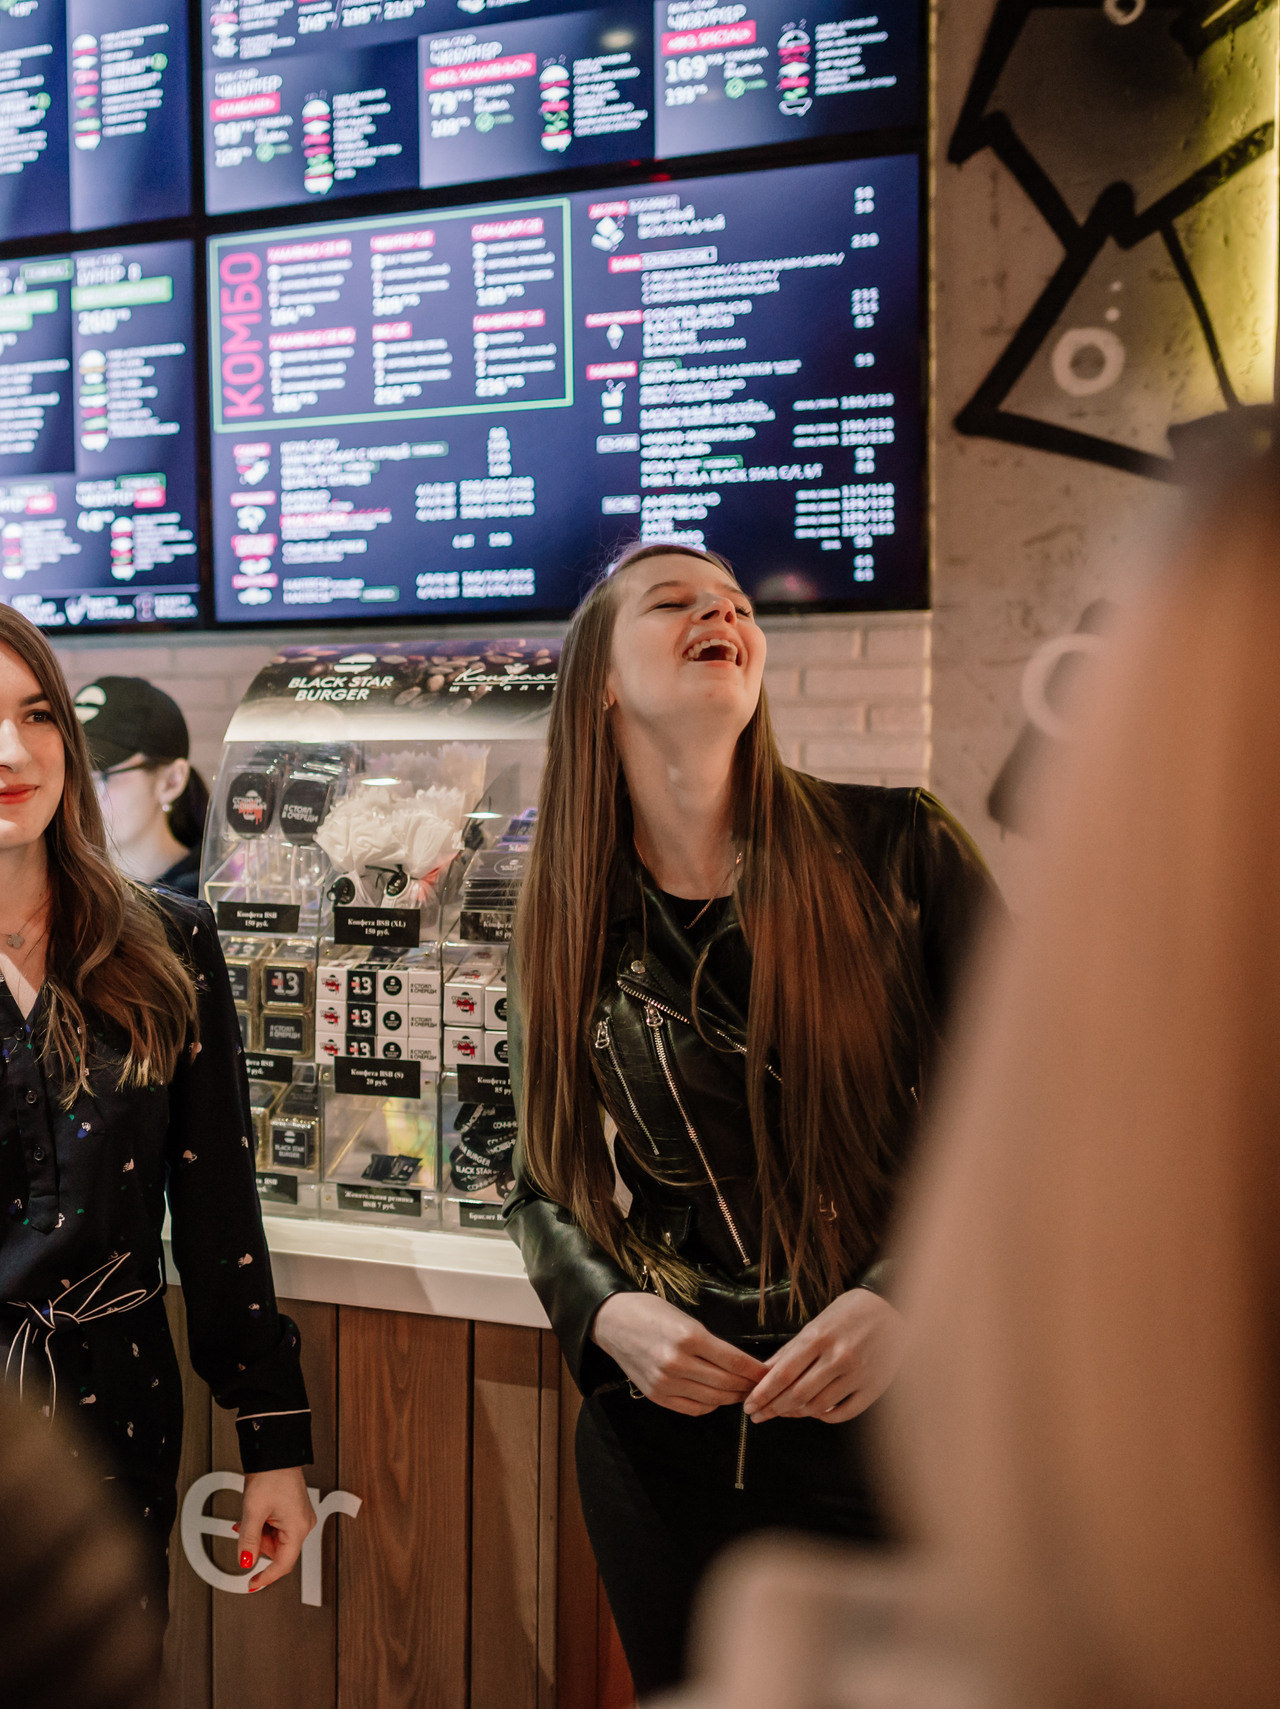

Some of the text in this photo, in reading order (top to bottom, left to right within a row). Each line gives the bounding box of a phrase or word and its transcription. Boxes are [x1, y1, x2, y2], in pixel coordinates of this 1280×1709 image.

[220, 252, 265, 418] КОМБО
[288, 675, 395, 689] BLACK STAR
[295, 689, 370, 701] BURGER
[236, 910, 277, 920] Конфета BSB
[347, 918, 407, 929] Конфета BSB (XL)
[364, 927, 390, 937] 150 руб.
[272, 971, 300, 996] 13
[352, 976, 373, 996] 13
[351, 1008, 372, 1028] 13
[350, 1041, 371, 1057] 13
[350, 1068, 379, 1079] Конфета
[380, 1070, 394, 1078] BSB
[375, 1079, 389, 1087] руб.
[477, 1076, 507, 1086] Конфета
[292, 1144, 305, 1152] STAR
[278, 1151, 300, 1159] BURGER
[466, 1149, 491, 1167] BURGER
[455, 1164, 492, 1176] BLACK STAR
[382, 1202, 396, 1210] руб.
[469, 1212, 496, 1221] Браслет
